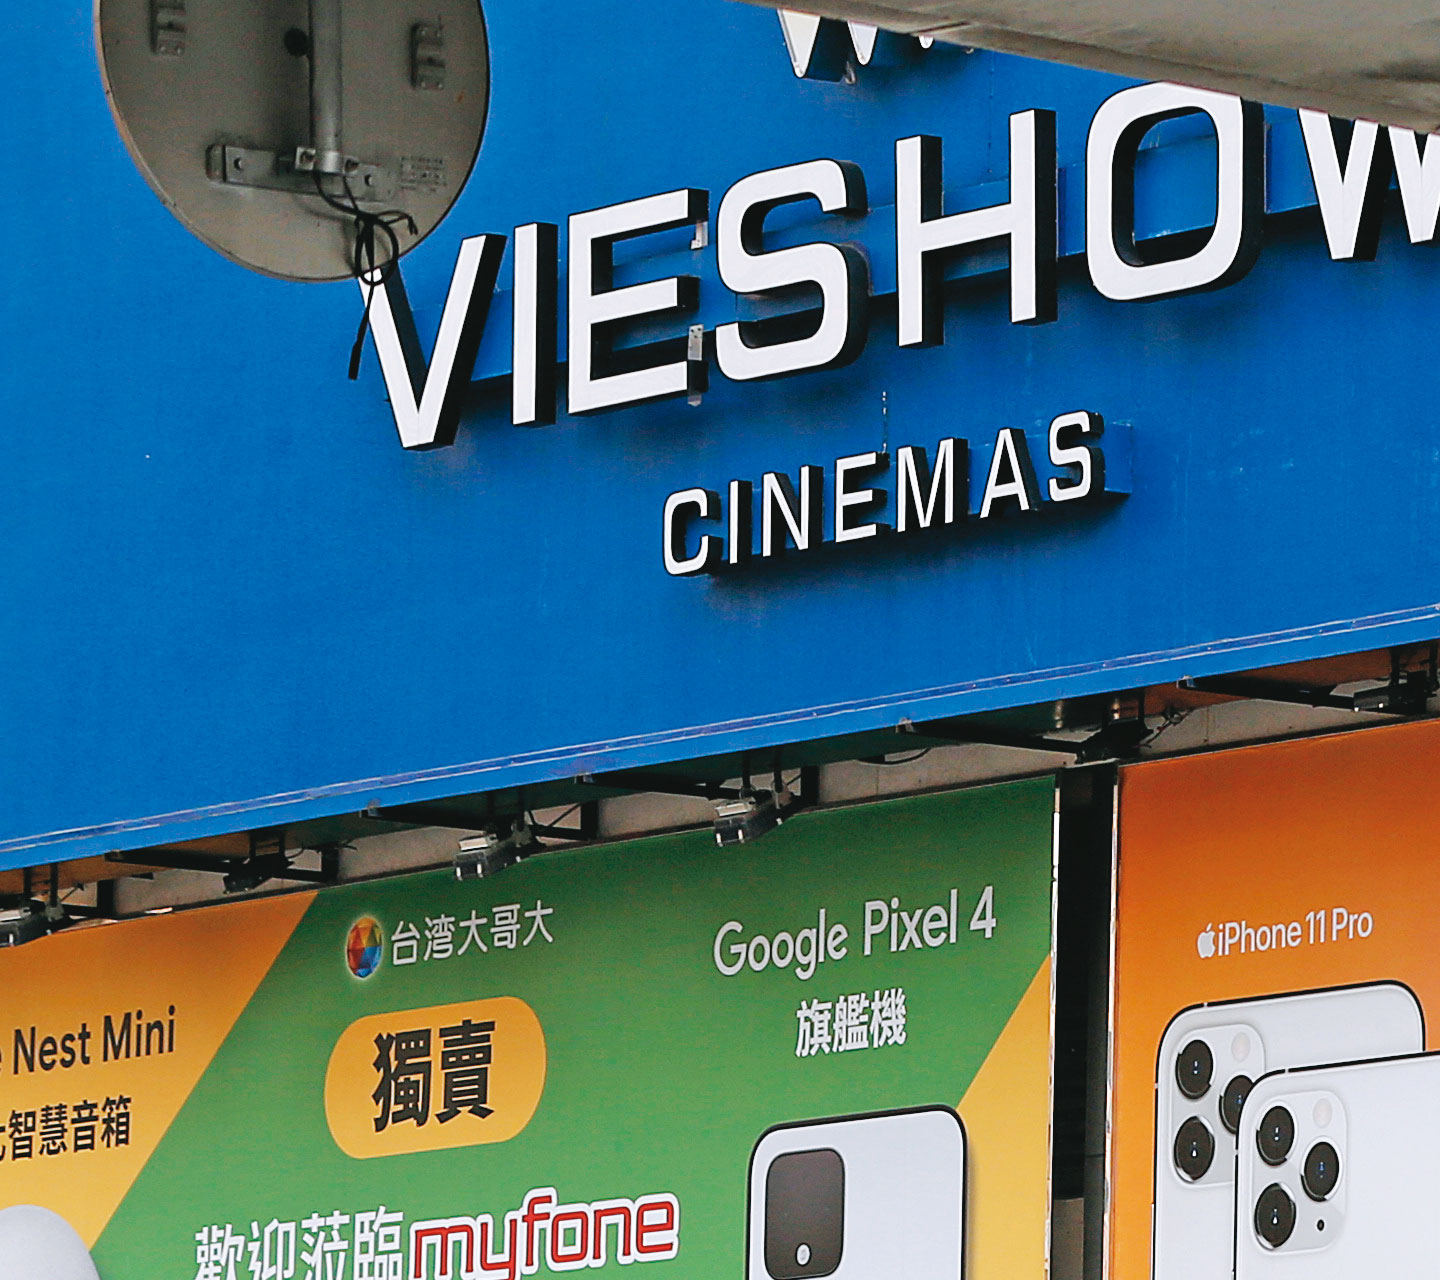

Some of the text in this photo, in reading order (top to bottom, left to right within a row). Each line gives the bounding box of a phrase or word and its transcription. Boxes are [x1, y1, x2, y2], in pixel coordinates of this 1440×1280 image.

[662, 409, 1103, 577] CINEMAS
[712, 886, 998, 980] Google Pixel 4
[1216, 906, 1374, 959] iPhone 11 Pro
[11, 1023, 92, 1076] Nest
[101, 1003, 177, 1067] Mini
[794, 987, 909, 1059] 旗艦機
[370, 1018, 499, 1133] 獨賣
